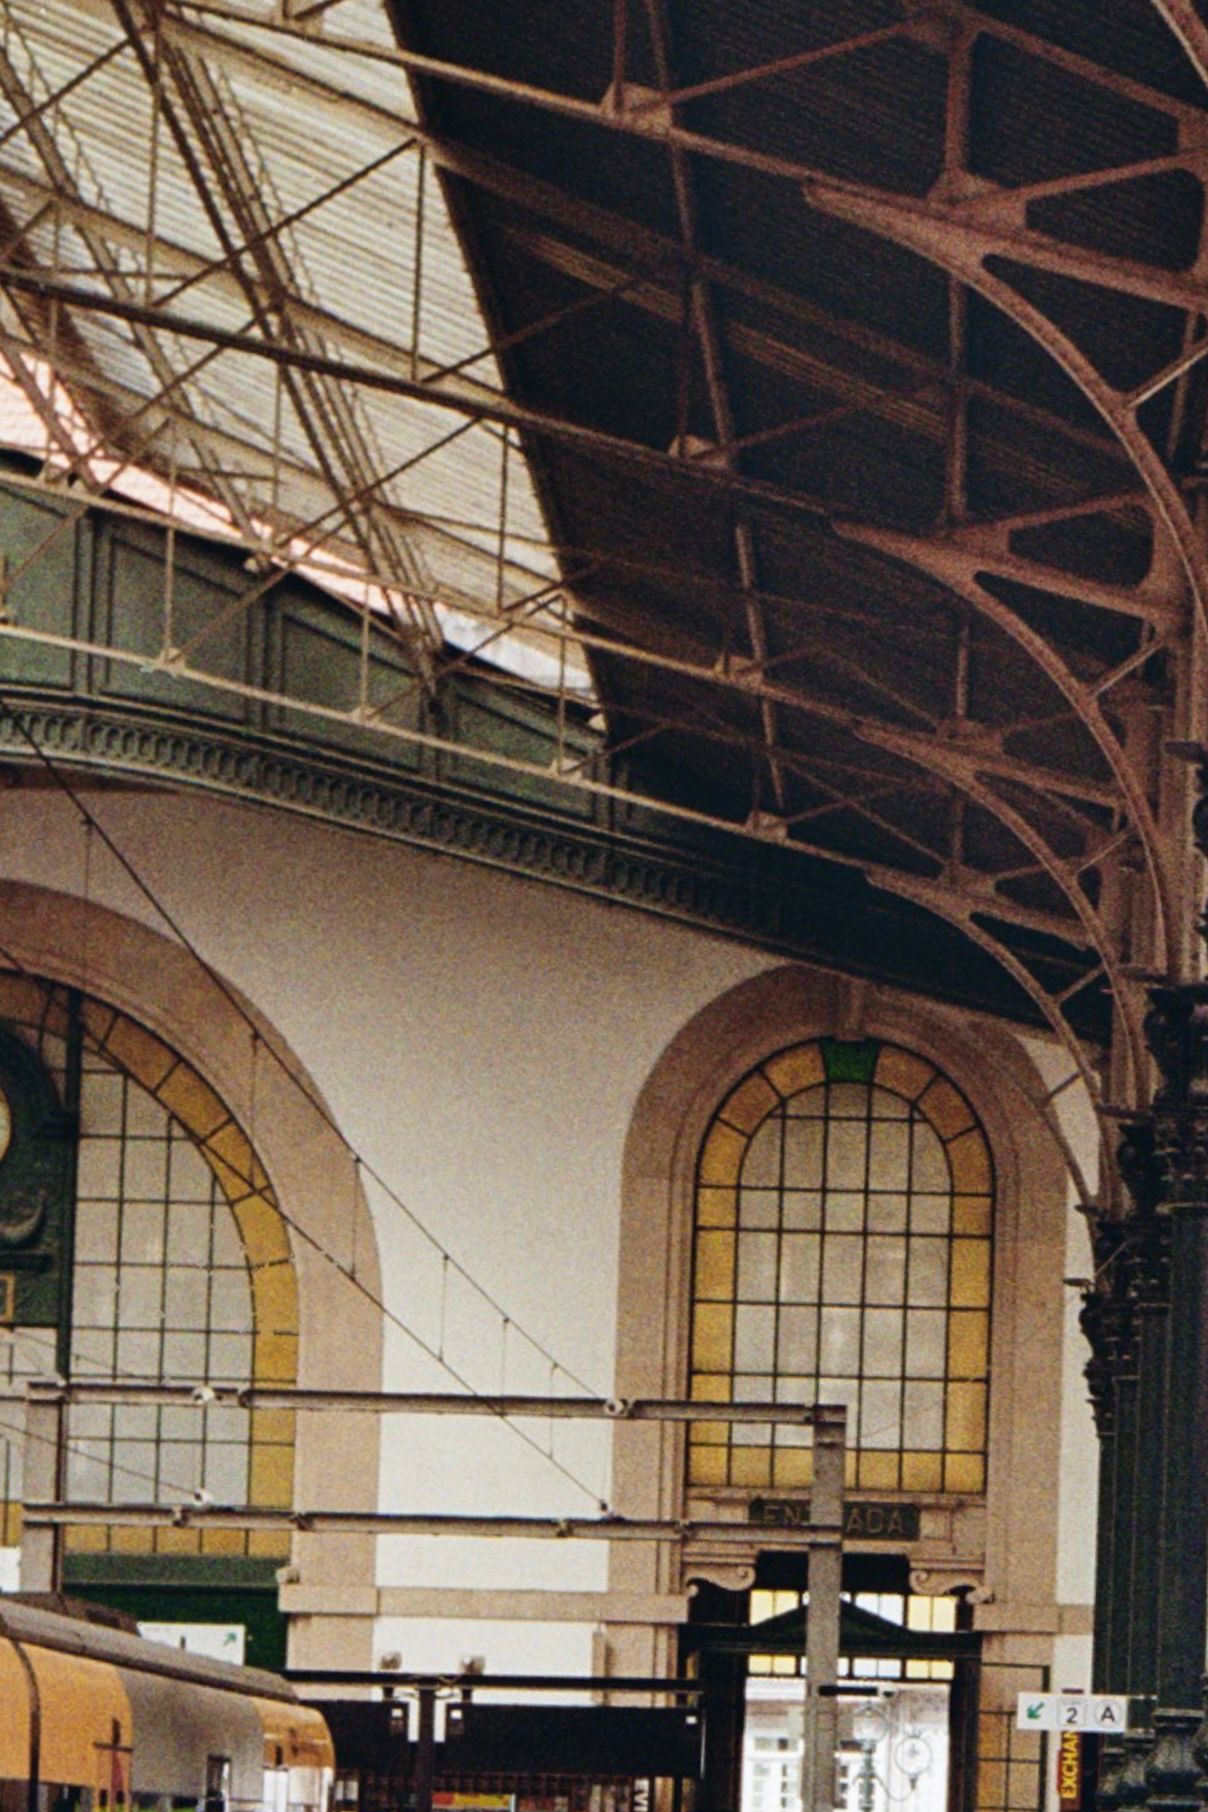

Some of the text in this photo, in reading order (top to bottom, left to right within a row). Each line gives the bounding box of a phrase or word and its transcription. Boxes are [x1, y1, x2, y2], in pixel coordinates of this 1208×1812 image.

[763, 1504, 905, 1534] ENADA
[1066, 1707, 1078, 1724] 2
[1101, 1706, 1116, 1722] A
[1061, 1731, 1079, 1799] EXCHAN
